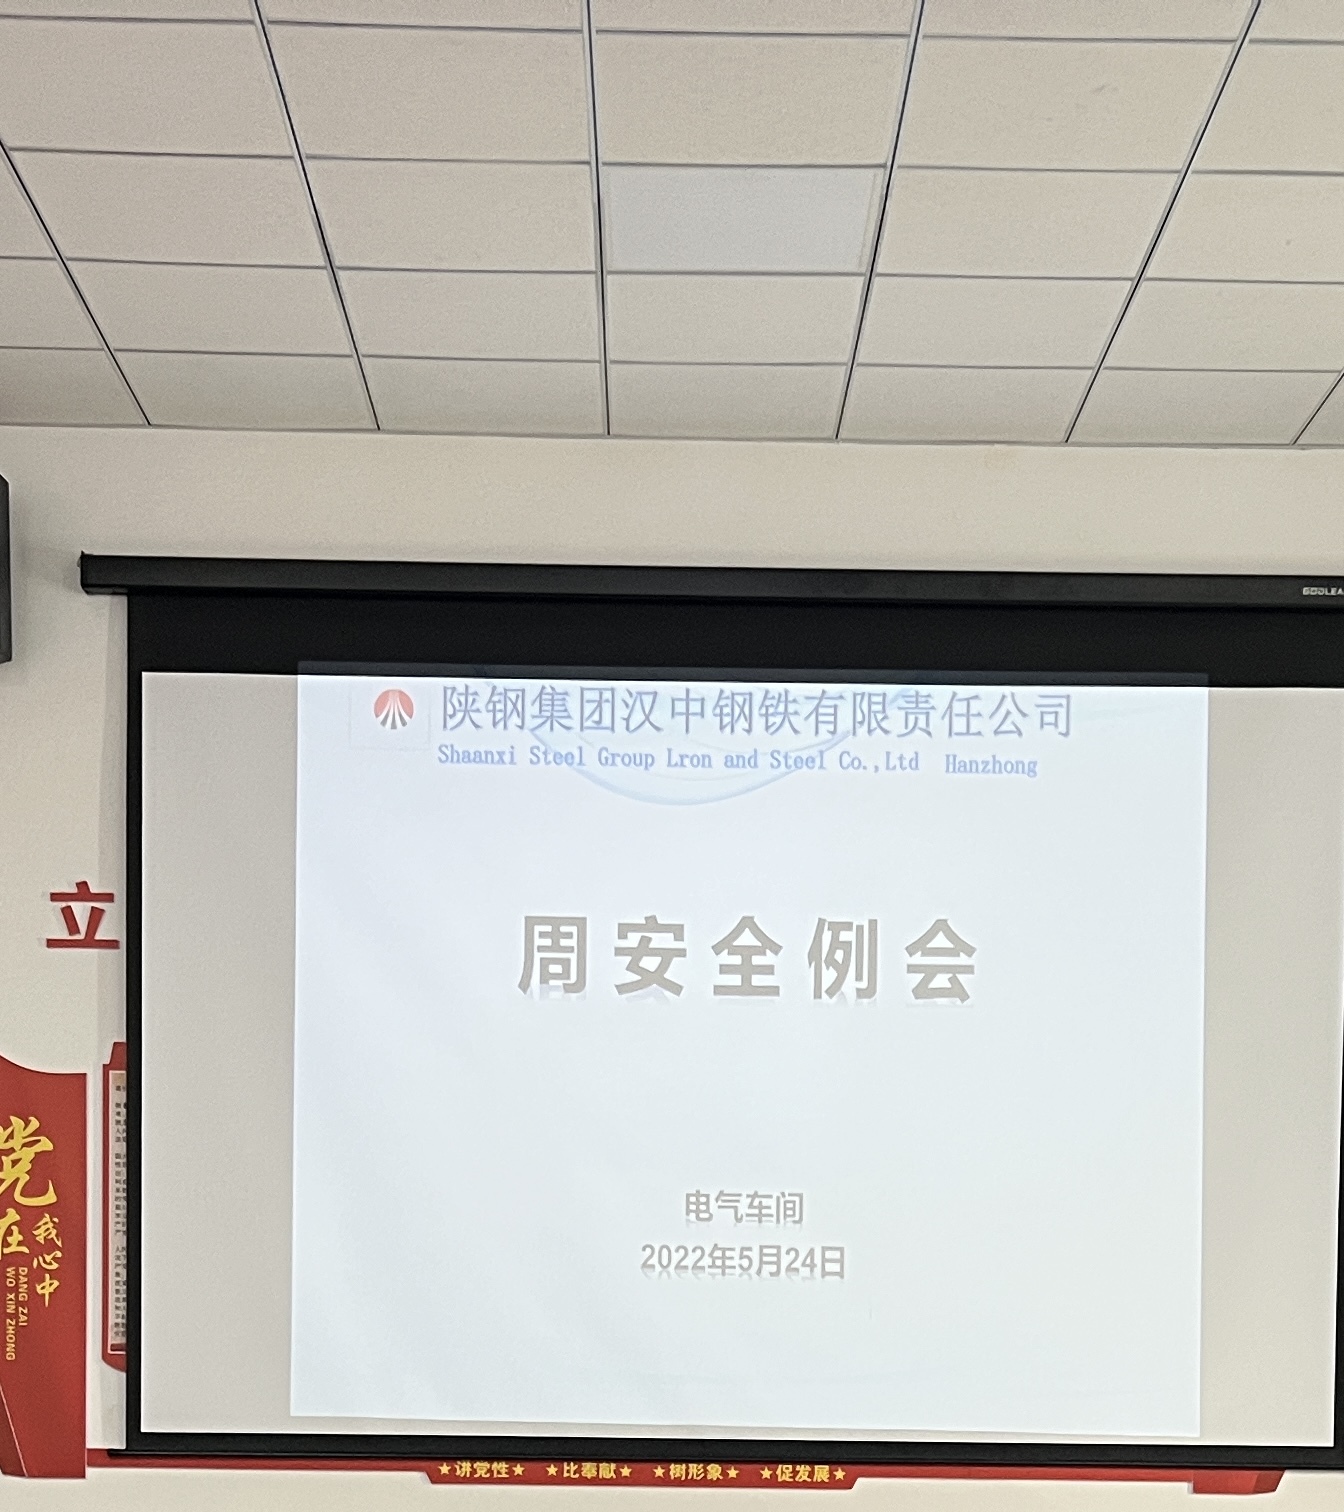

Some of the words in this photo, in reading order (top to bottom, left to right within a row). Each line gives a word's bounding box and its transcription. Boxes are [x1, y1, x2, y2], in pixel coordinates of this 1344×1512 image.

[441, 684, 1072, 738] 陕钢集团汉中钢铁有限责任公司
[437, 744, 517, 766] Shaanxi
[529, 745, 586, 767] Steel
[597, 746, 656, 771] Group
[666, 748, 713, 769] Lron
[723, 748, 759, 769] and
[769, 750, 825, 771] Steel
[945, 754, 1038, 778] Hanzhong
[46, 880, 120, 950] 立
[516, 915, 977, 1003] 周安全例会
[684, 1189, 804, 1226] 电气车间
[6, 1266, 16, 1288] WO
[640, 1243, 847, 1280] 2022年5月24日
[18, 1267, 28, 1301] DANG
[6, 1292, 16, 1314] XIN
[18, 1305, 28, 1327] ZAI
[6, 1318, 16, 1361] ZHONG
[454, 1460, 510, 1479] 讲党性
[562, 1461, 617, 1480] 比奉献
[668, 1462, 724, 1481] 树形象
[775, 1464, 831, 1483] 促发展
